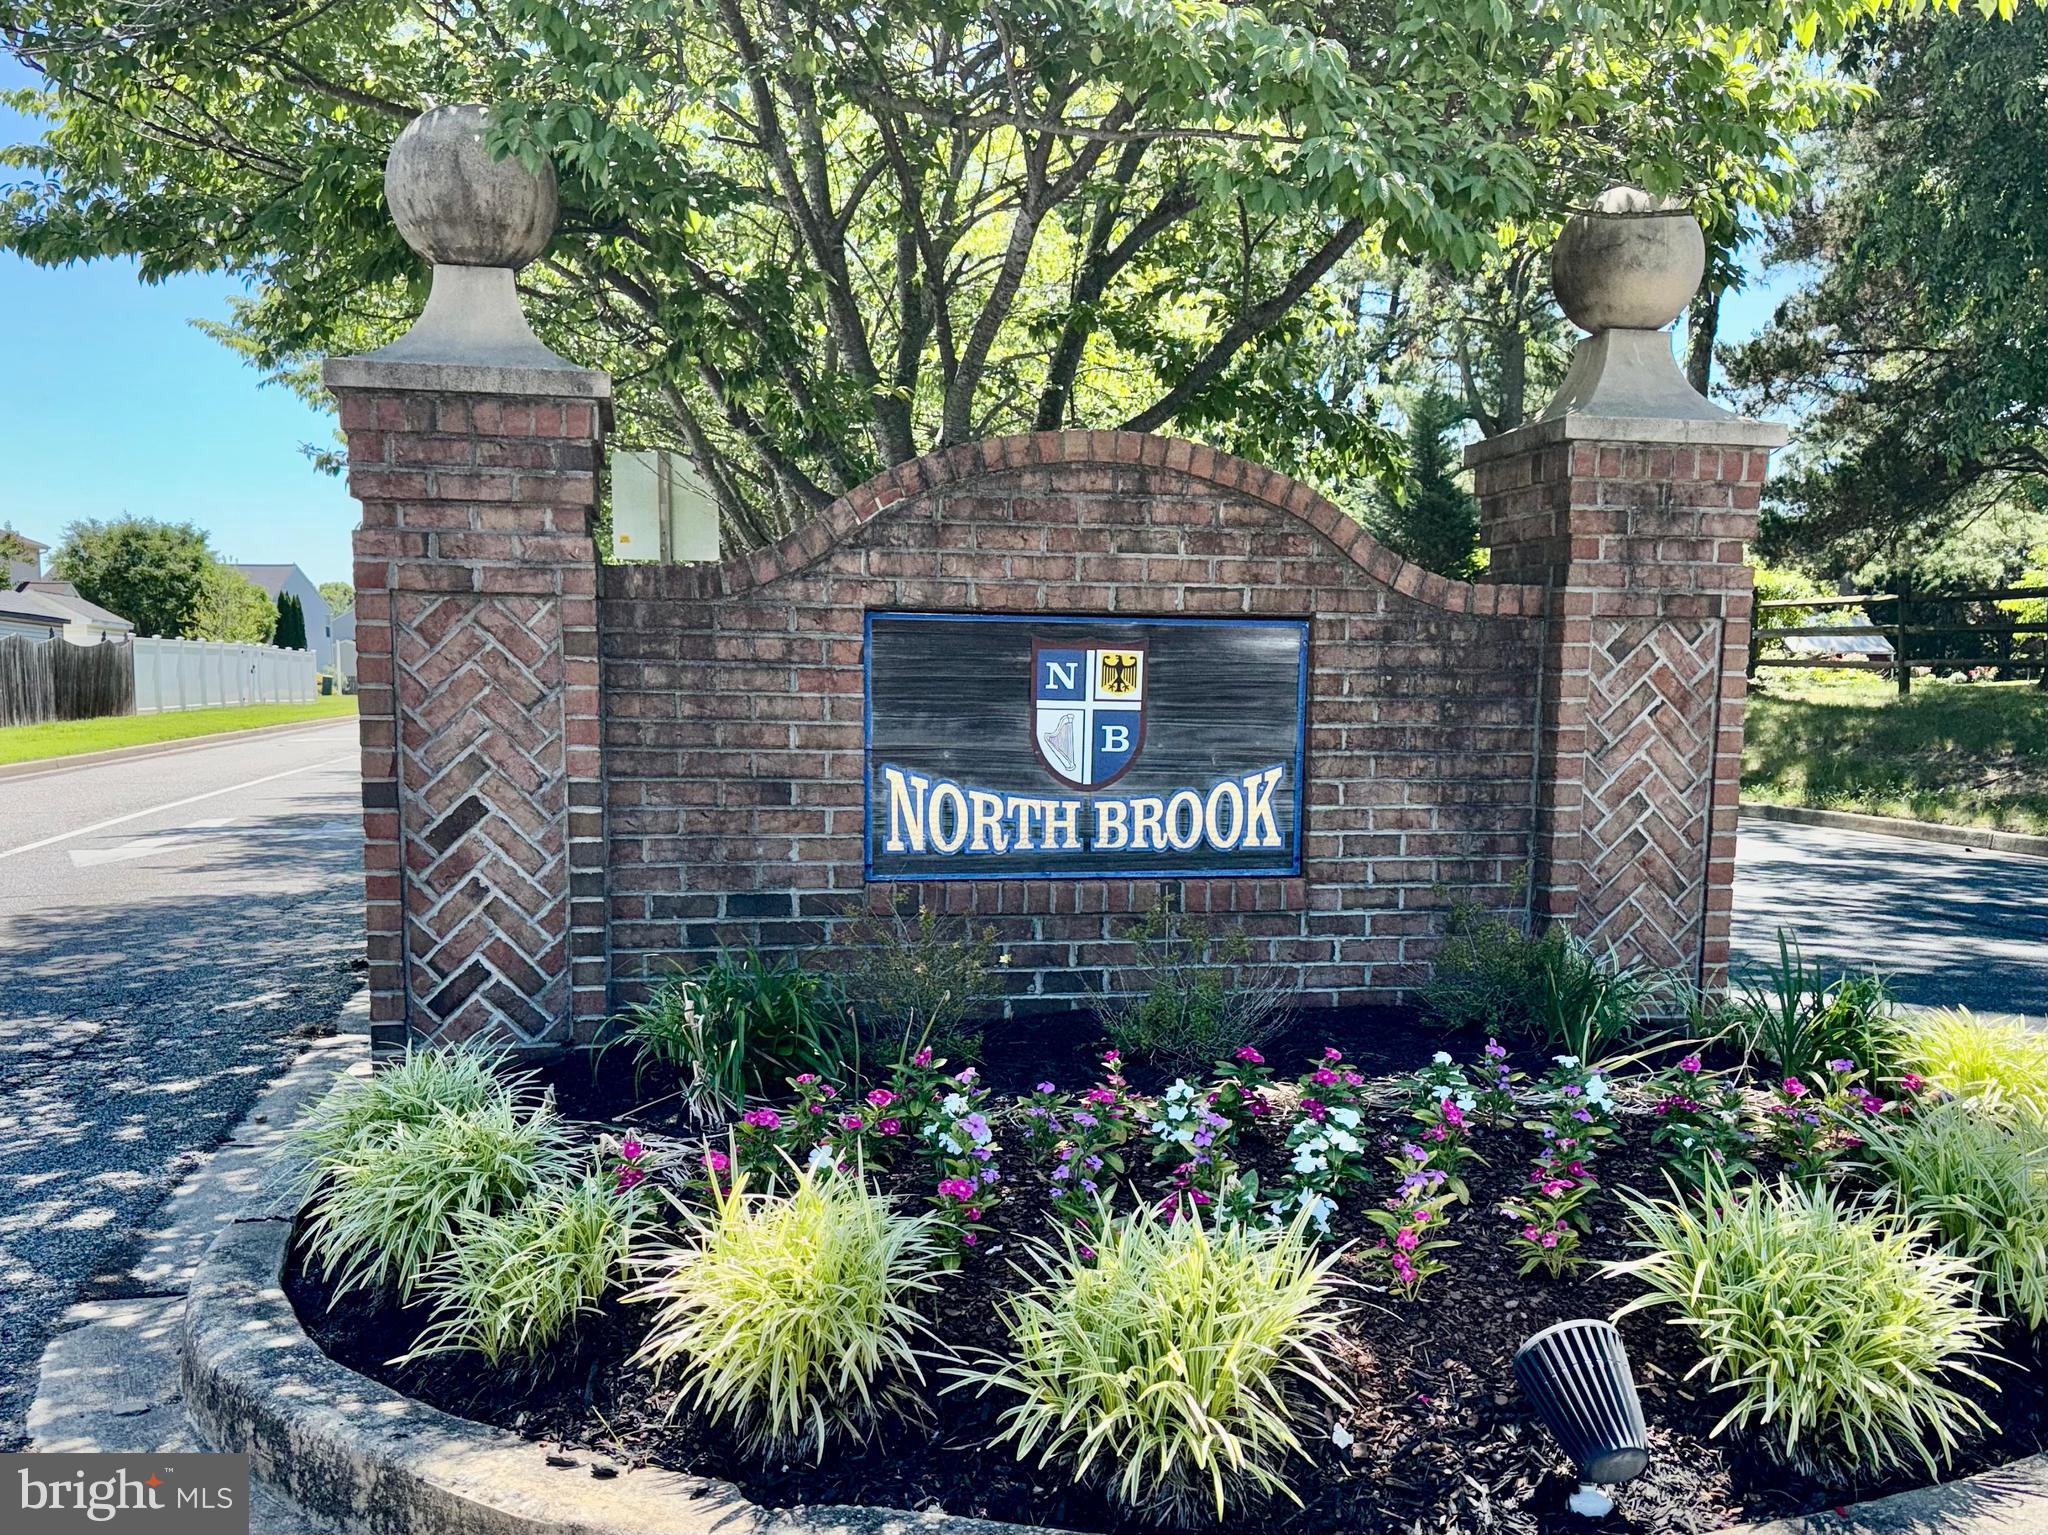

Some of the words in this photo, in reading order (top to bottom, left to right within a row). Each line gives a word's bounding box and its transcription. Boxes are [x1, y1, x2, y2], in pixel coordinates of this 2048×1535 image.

[1044, 661, 1079, 691] N
[1100, 724, 1131, 753] B
[884, 766, 1081, 854] NORTH
[1092, 765, 1284, 851] BROOK
